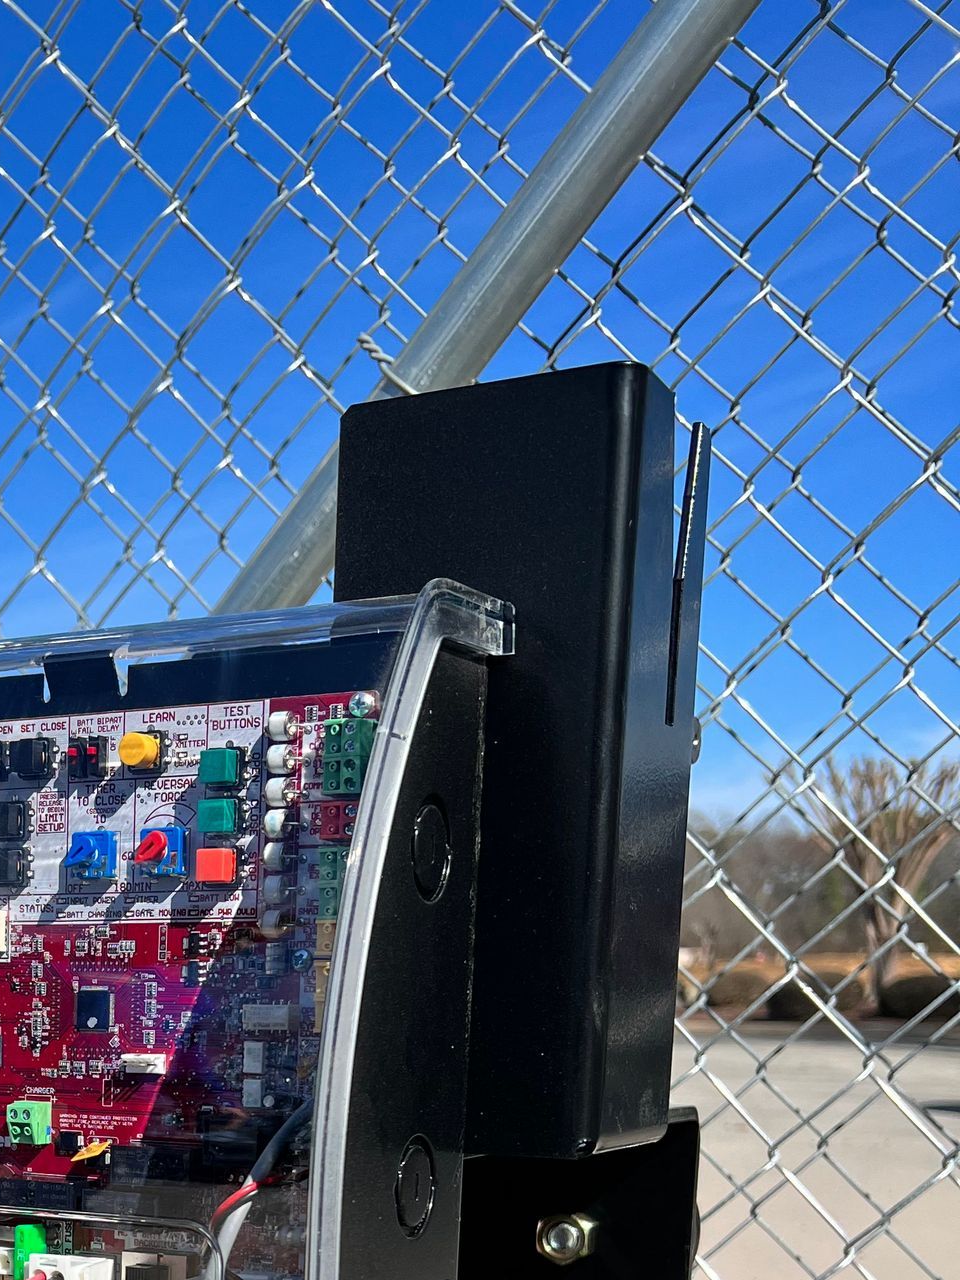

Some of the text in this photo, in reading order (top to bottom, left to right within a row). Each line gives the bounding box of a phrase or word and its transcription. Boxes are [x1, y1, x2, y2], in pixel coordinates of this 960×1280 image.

[224, 705, 250, 717] TEST
[77, 716, 122, 727] BATT BIPART
[142, 711, 176, 724] LEARN
[20, 723, 36, 733] SET
[40, 721, 67, 732] CLOSE
[78, 724, 120, 735] FAIL DELAY
[212, 717, 261, 731] BUTTONS
[175, 739, 206, 749] XMITTER
[251, 752, 260, 778] OPEN
[110, 766, 117, 777] ON
[85, 783, 116, 794] TIMER
[144, 778, 197, 790] REVERSAL
[77, 794, 127, 807] TO CLOSE
[153, 791, 187, 803] FORCE
[39, 813, 64, 822] LIMIT
[249, 800, 259, 837] CLOSE
[38, 823, 65, 832] SETUP
[248, 851, 258, 882] STOP
[68, 883, 83, 893] OFF
[114, 882, 132, 892] 180
[134, 881, 152, 891] MIN
[67, 896, 89, 904] INPUT
[200, 893, 240, 903] BATT LOW
[19, 904, 54, 913] STATUS:
[67, 910, 121, 918] BATT CHARGING
[135, 908, 186, 917] GATE MOVING
[217, 908, 232, 916] PWR
[25, 1086, 55, 1095] CHARGER
